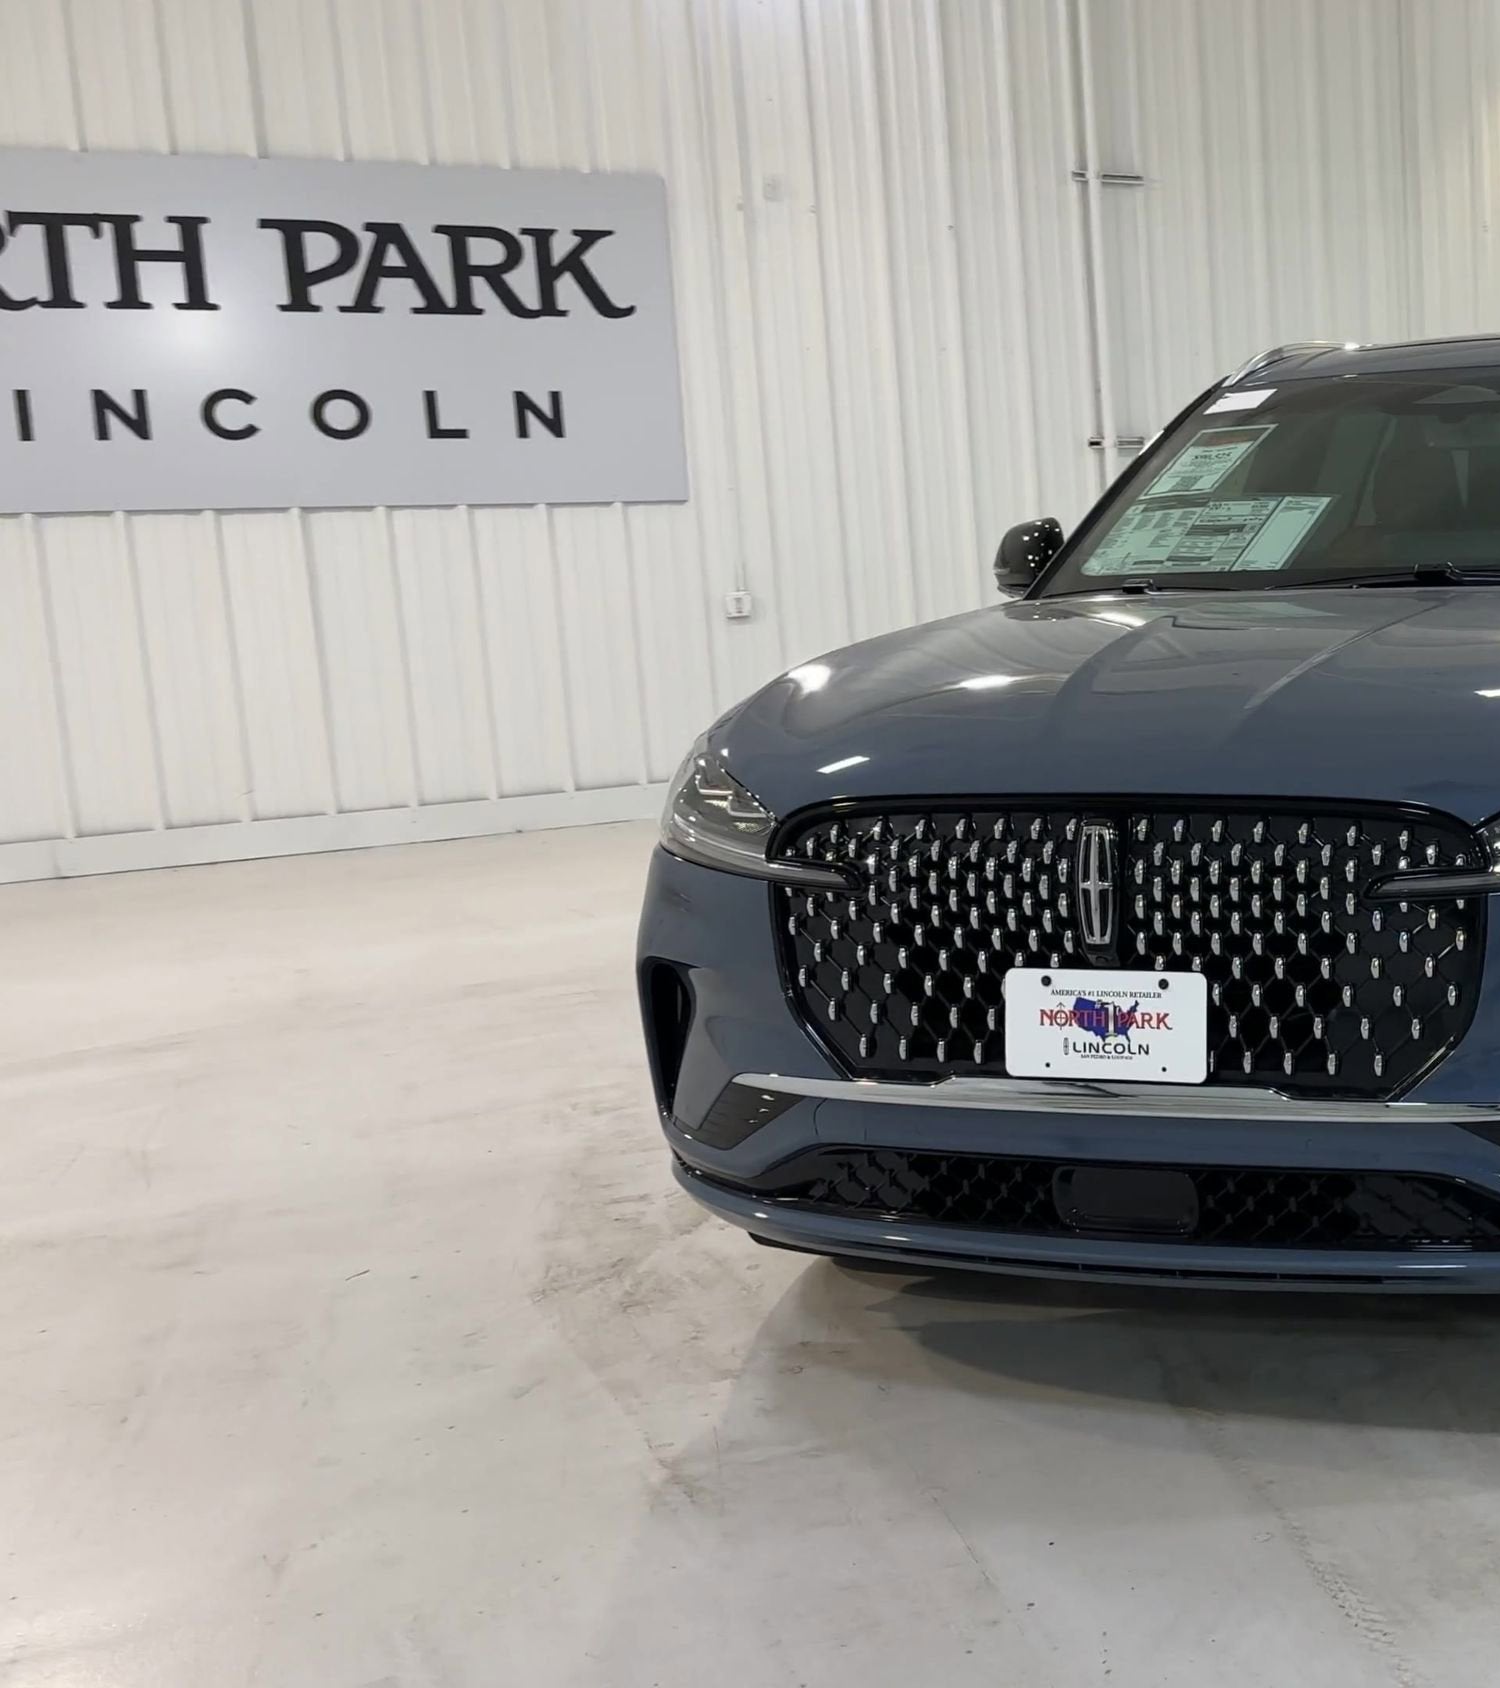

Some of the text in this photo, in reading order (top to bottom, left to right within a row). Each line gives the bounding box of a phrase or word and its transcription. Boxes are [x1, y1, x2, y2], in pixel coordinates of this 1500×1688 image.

[257, 217, 636, 320] PARK
[1050, 989, 1087, 997] AMERICA'S
[1096, 990, 1128, 998] LINCOLN
[1129, 991, 1162, 999] RETAILER
[1039, 1009, 1173, 1030] NORTH PARK
[1072, 1041, 1150, 1056] LINCOLN
